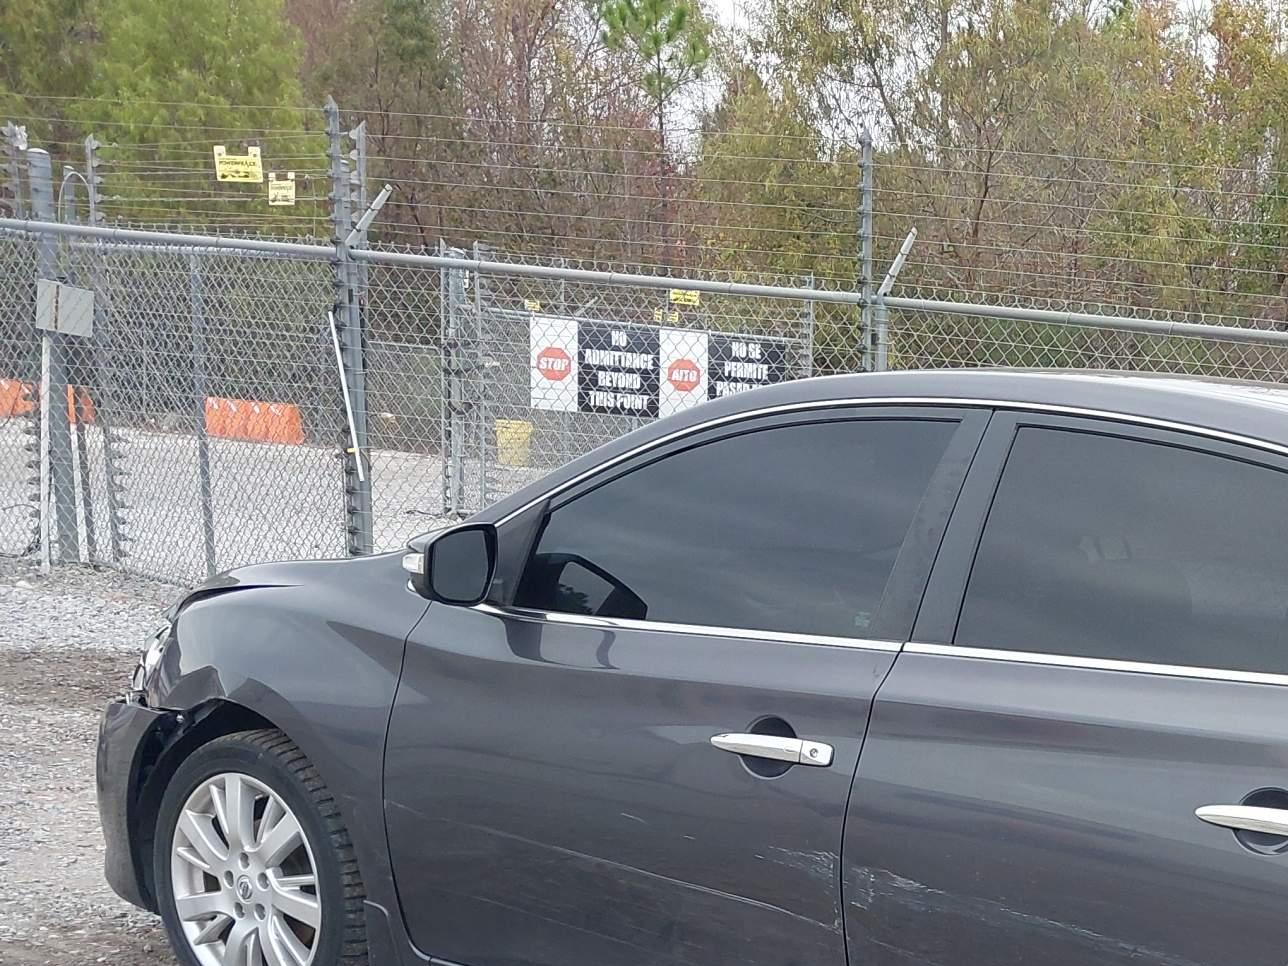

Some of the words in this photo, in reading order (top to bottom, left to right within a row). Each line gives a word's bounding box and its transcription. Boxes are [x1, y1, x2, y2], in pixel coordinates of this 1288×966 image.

[611, 330, 627, 347] NO
[584, 349, 654, 369] ADMITTANCE
[732, 341, 747, 358] NO
[748, 343, 761, 359] SE
[538, 356, 569, 371] STOP
[724, 361, 769, 380] PERMITE
[597, 371, 641, 389] BEYOND
[589, 391, 614, 408] THIS
[616, 394, 650, 409] POINT
